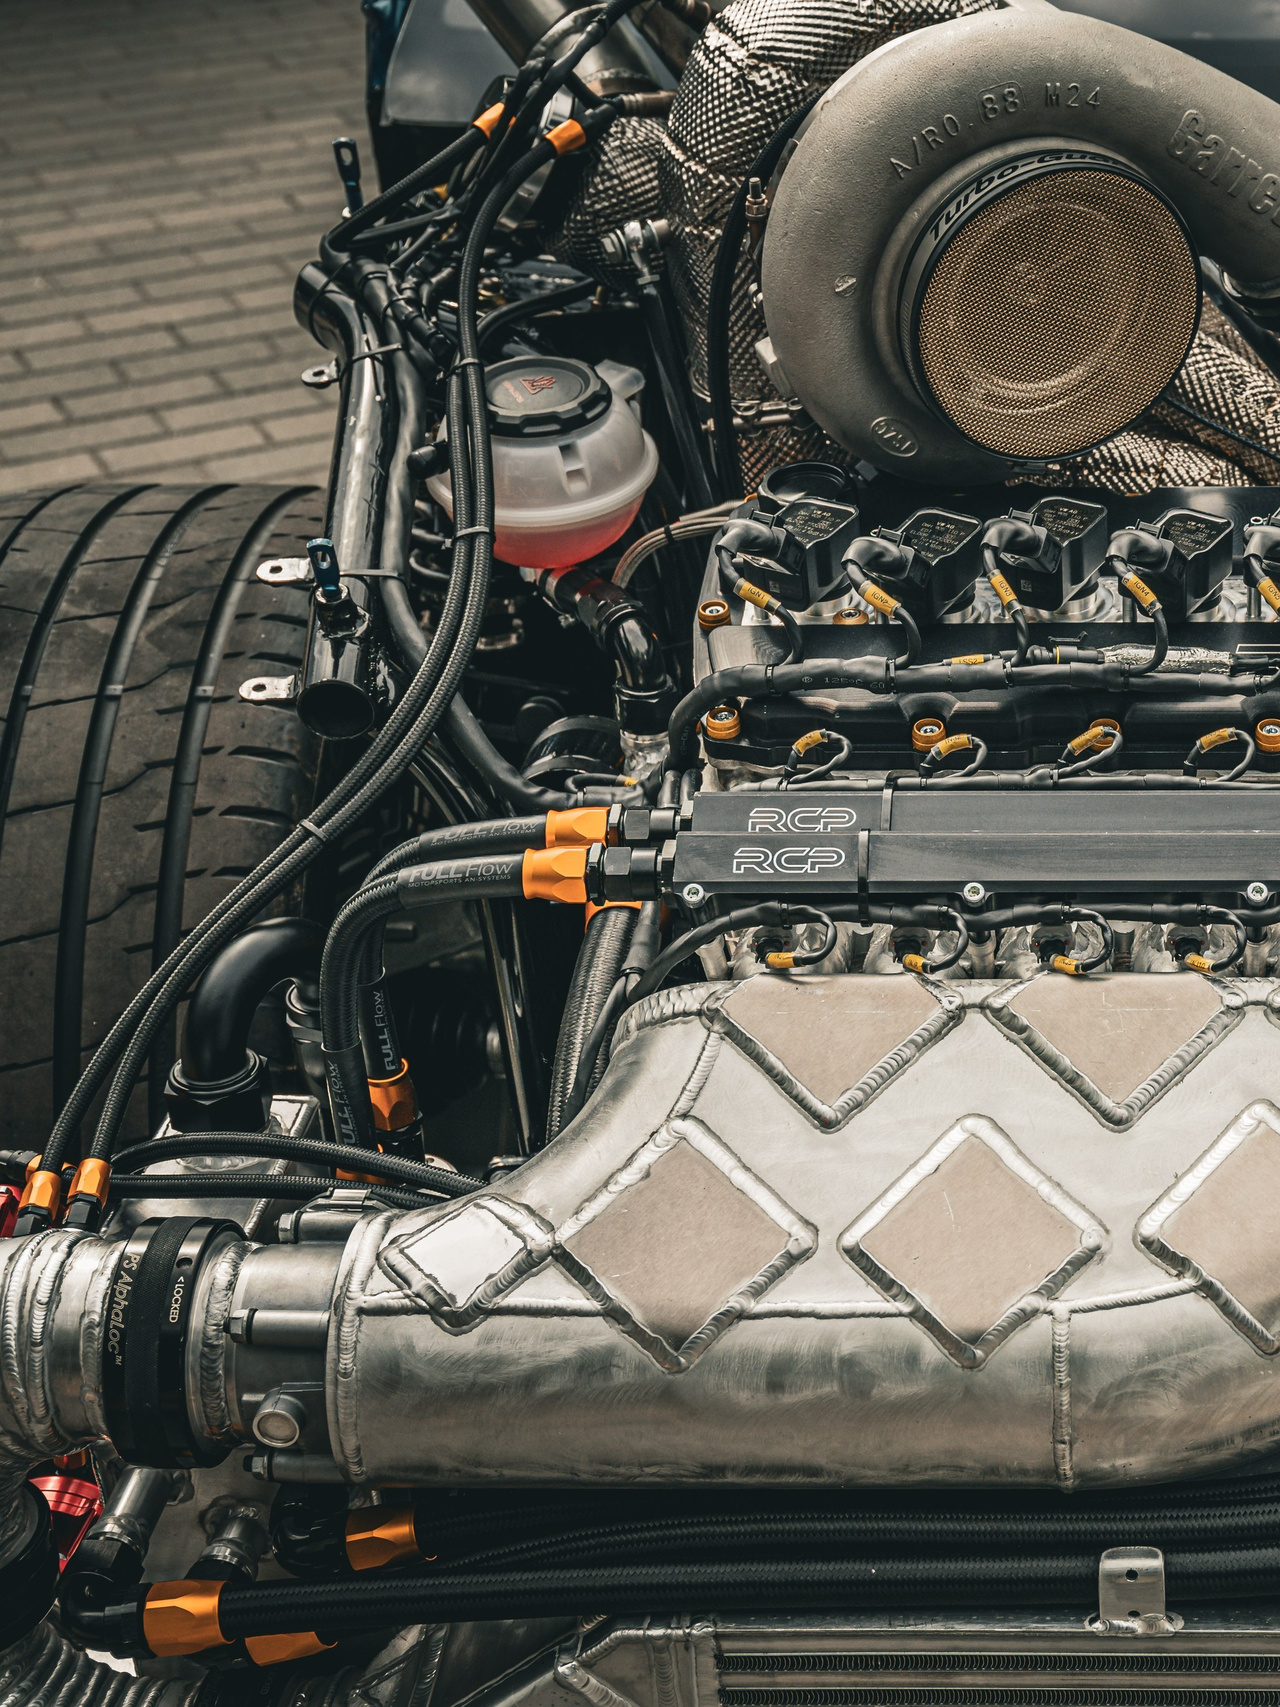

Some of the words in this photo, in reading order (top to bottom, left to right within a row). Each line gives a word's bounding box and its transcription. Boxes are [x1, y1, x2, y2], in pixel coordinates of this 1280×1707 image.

[1045, 82, 1101, 108] M24
[747, 586, 765, 600] IGN1
[998, 580, 1012, 597] IGN3
[1133, 580, 1150, 597] IGN4
[748, 807, 857, 833] RCP
[432, 827, 487, 842] FULL
[733, 847, 845, 874] RCP
[407, 878, 462, 888] MOTORSPORTS
[409, 862, 464, 883] FULL
[378, 1028, 398, 1072] FULL
[338, 1106, 357, 1145] ULL
[169, 1284, 184, 1323] LOCKED
